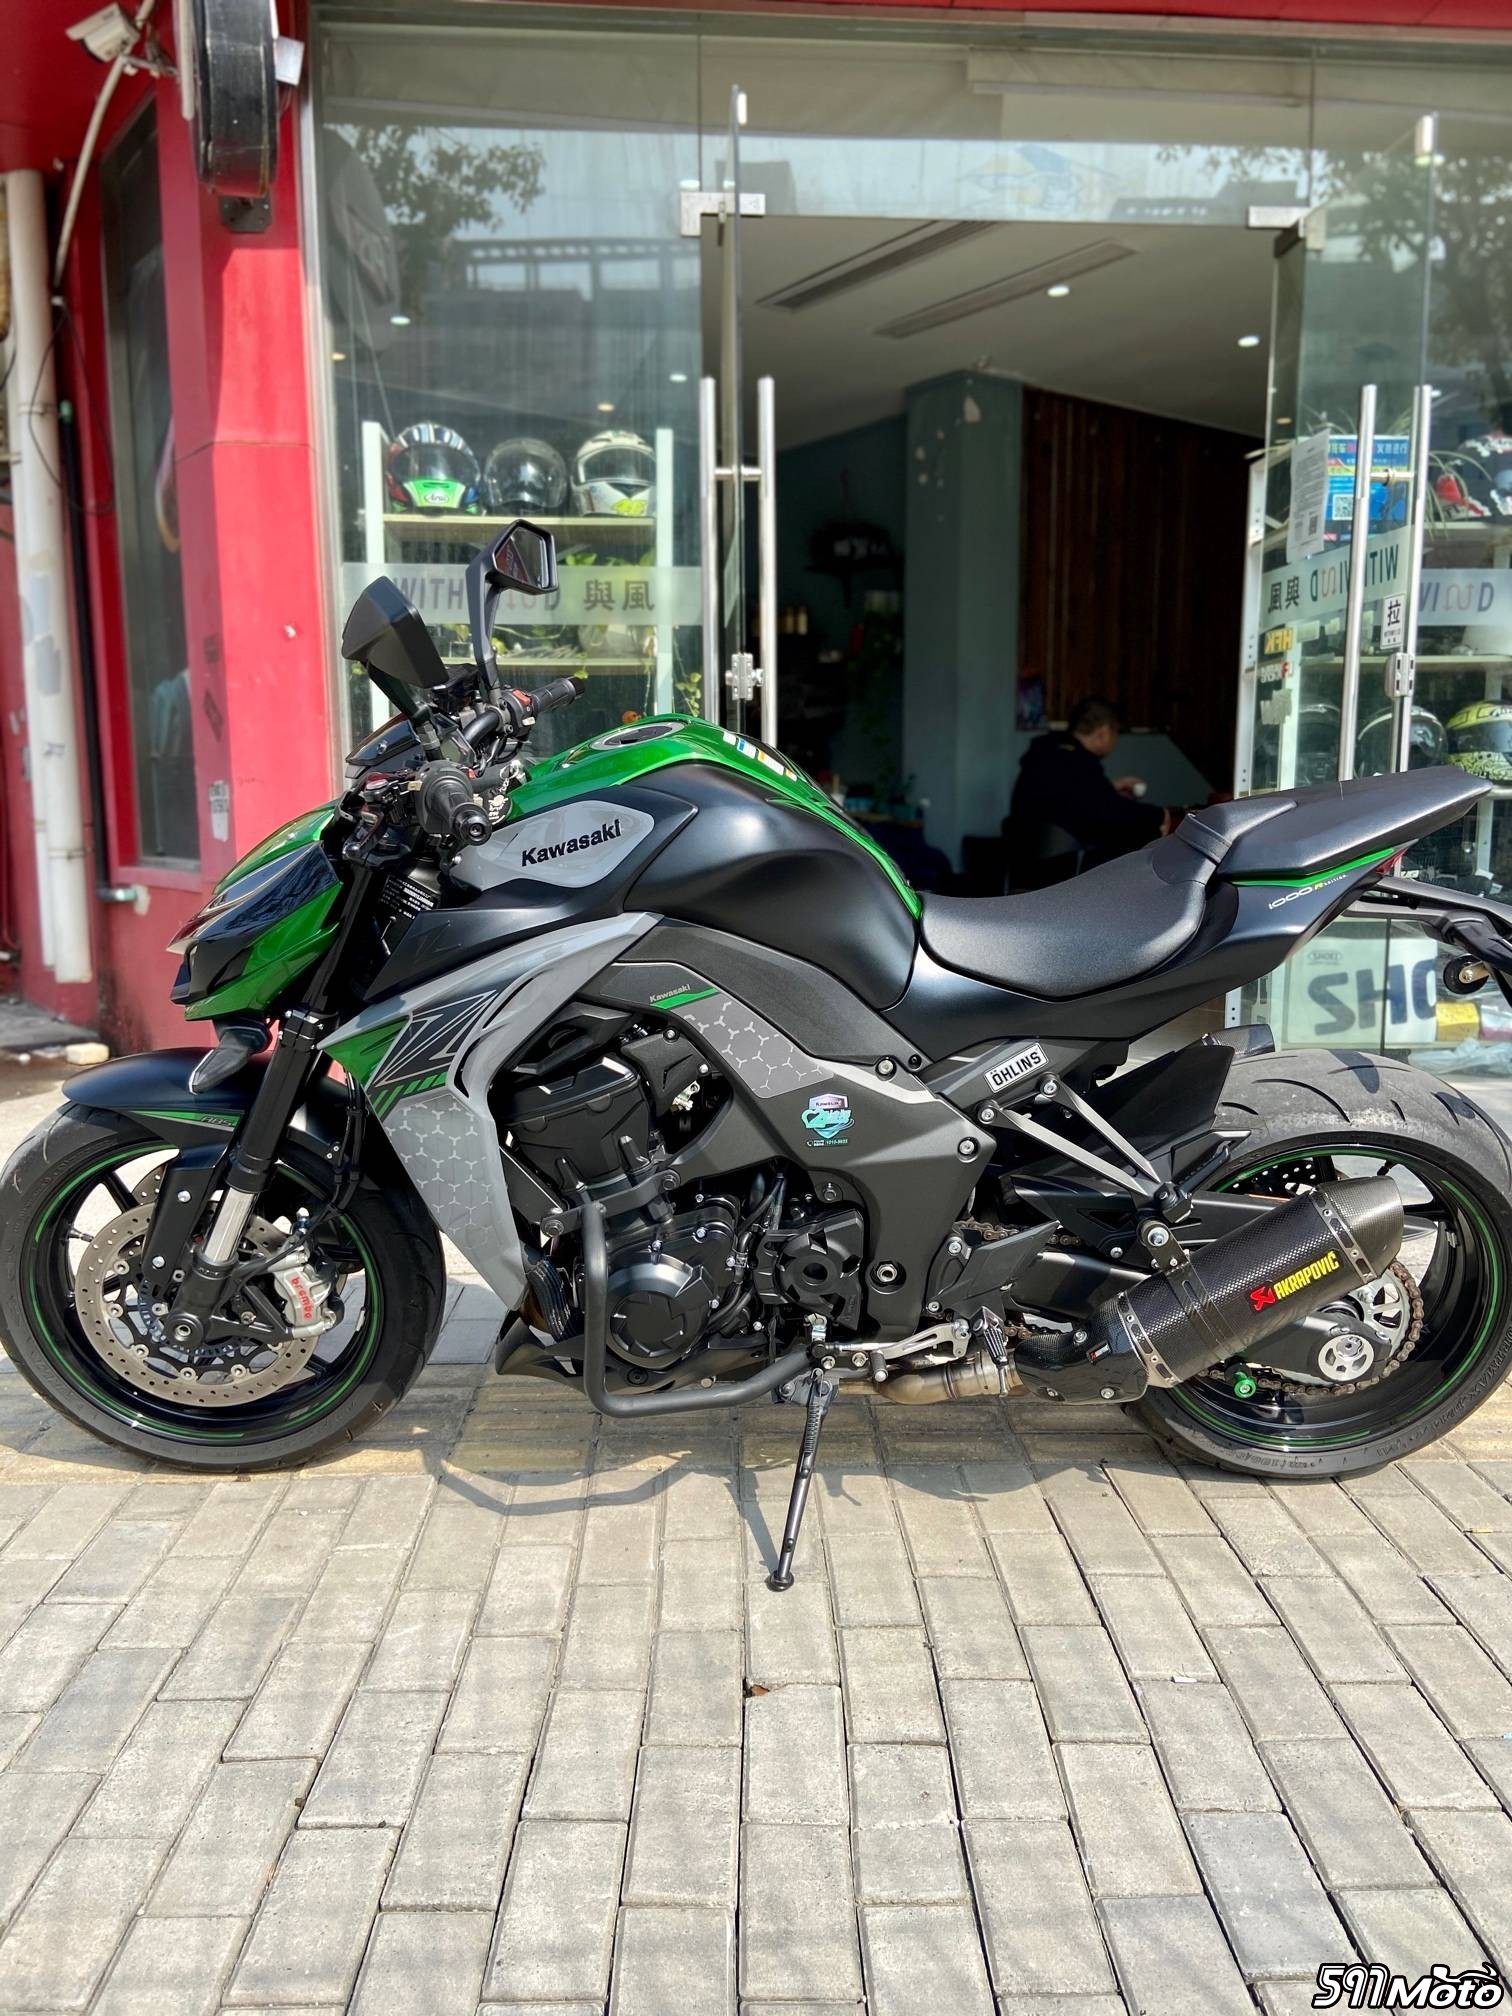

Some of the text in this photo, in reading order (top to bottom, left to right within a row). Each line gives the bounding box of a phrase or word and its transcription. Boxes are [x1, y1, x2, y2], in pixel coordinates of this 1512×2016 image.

[583, 579, 655, 612] 與風
[1387, 599, 1401, 627] 拉
[521, 818, 622, 867] Kawasaki
[649, 983, 691, 1003] Kawasaki
[990, 1051, 1042, 1087] ÖHLINS
[291, 1276, 313, 1320] brembo
